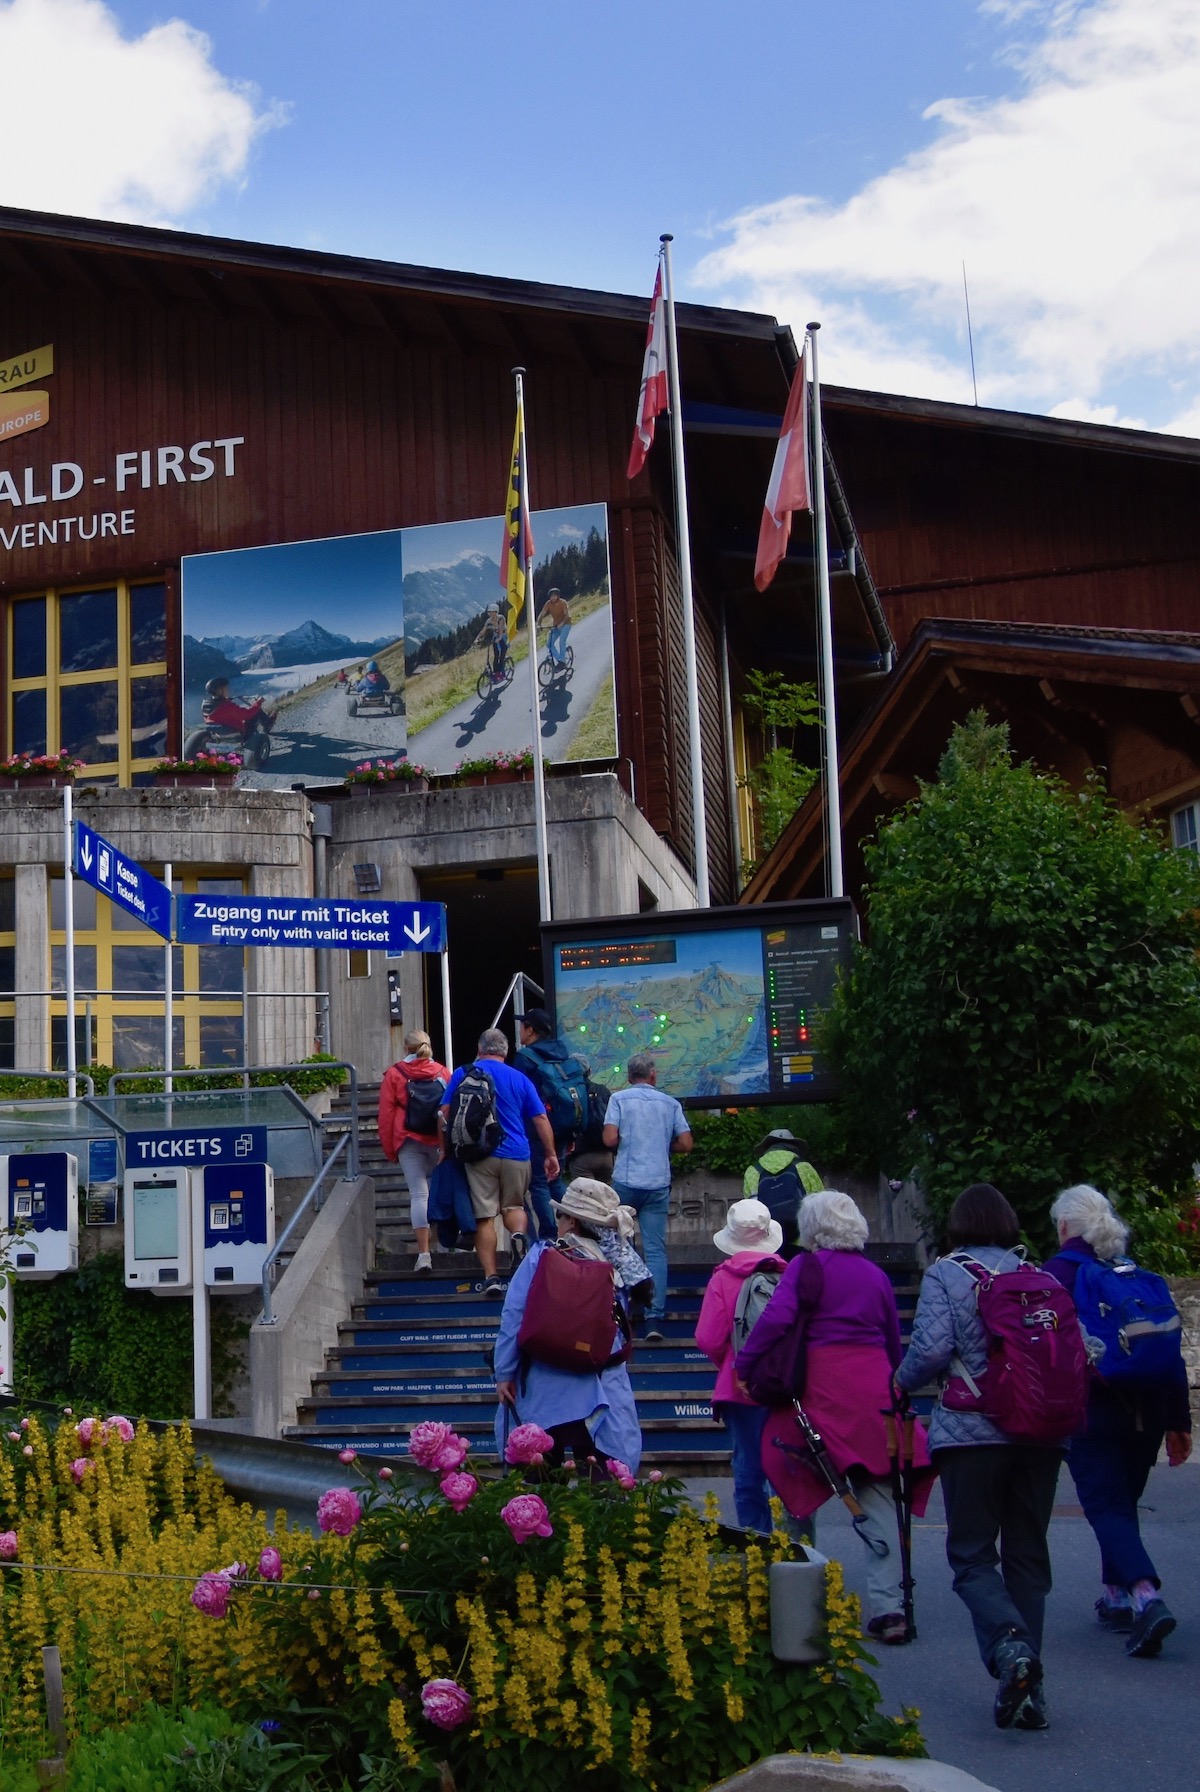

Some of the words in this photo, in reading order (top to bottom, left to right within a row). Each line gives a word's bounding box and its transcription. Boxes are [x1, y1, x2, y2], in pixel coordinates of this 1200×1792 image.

[115, 437, 245, 492] FIRST
[117, 860, 138, 888] Kasse
[116, 882, 134, 904] Ticket
[133, 895, 146, 913] desk
[194, 903, 261, 924] Zugang
[267, 909, 297, 922] nur
[302, 905, 330, 922] mit
[334, 906, 390, 924] Ticket
[211, 924, 247, 940] Entry
[251, 925, 280, 941] only
[283, 926, 313, 939] with
[315, 927, 348, 940] valid
[351, 928, 390, 942] ticket
[137, 1138, 222, 1158] TICKETS
